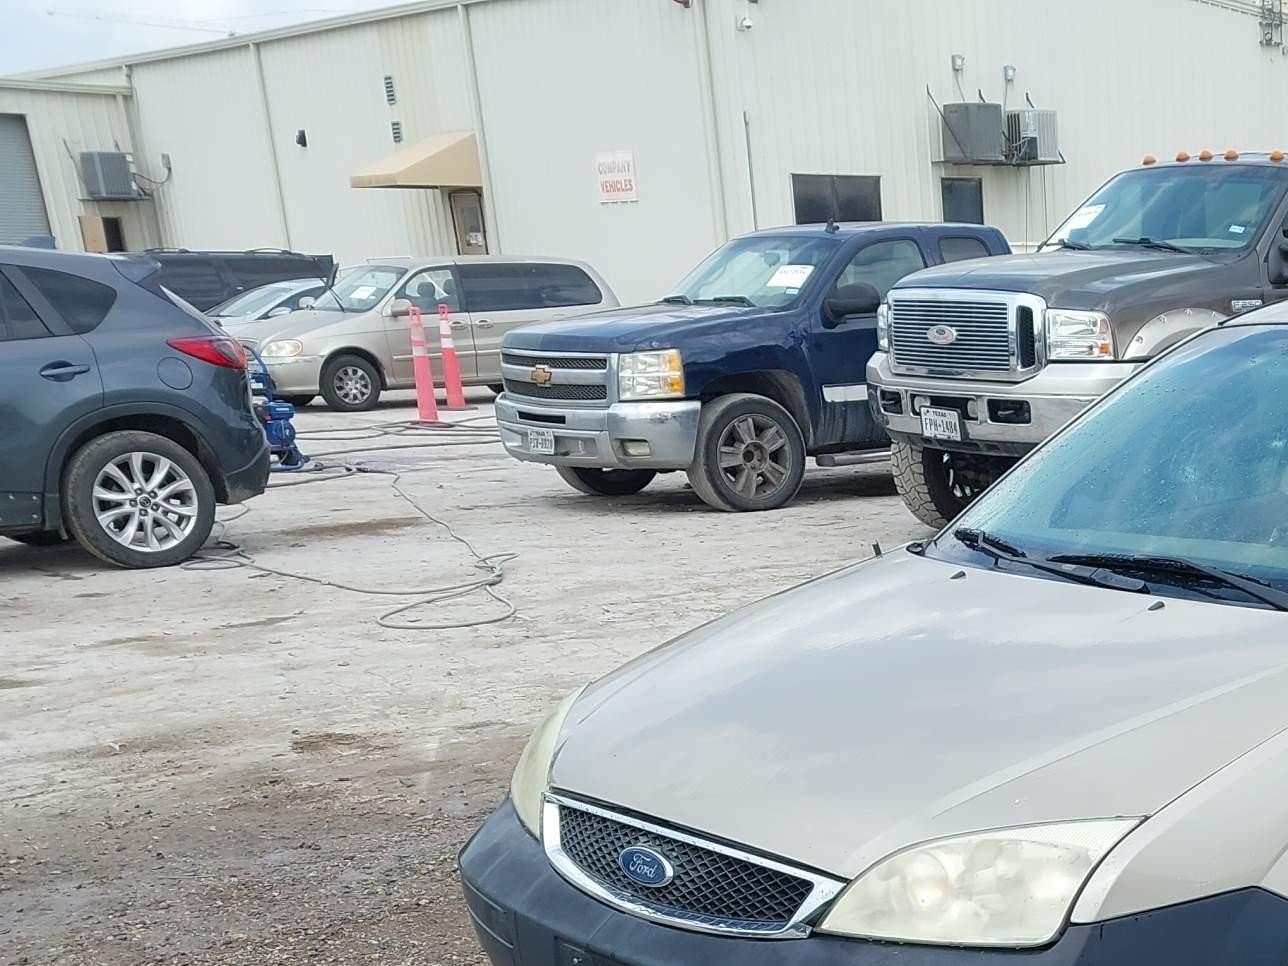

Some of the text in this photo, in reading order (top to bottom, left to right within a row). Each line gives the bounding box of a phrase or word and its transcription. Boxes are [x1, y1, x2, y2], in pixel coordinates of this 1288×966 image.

[598, 160, 631, 175] COMPANY
[600, 179, 633, 192] VEHICLES
[630, 853, 658, 878] Ford
